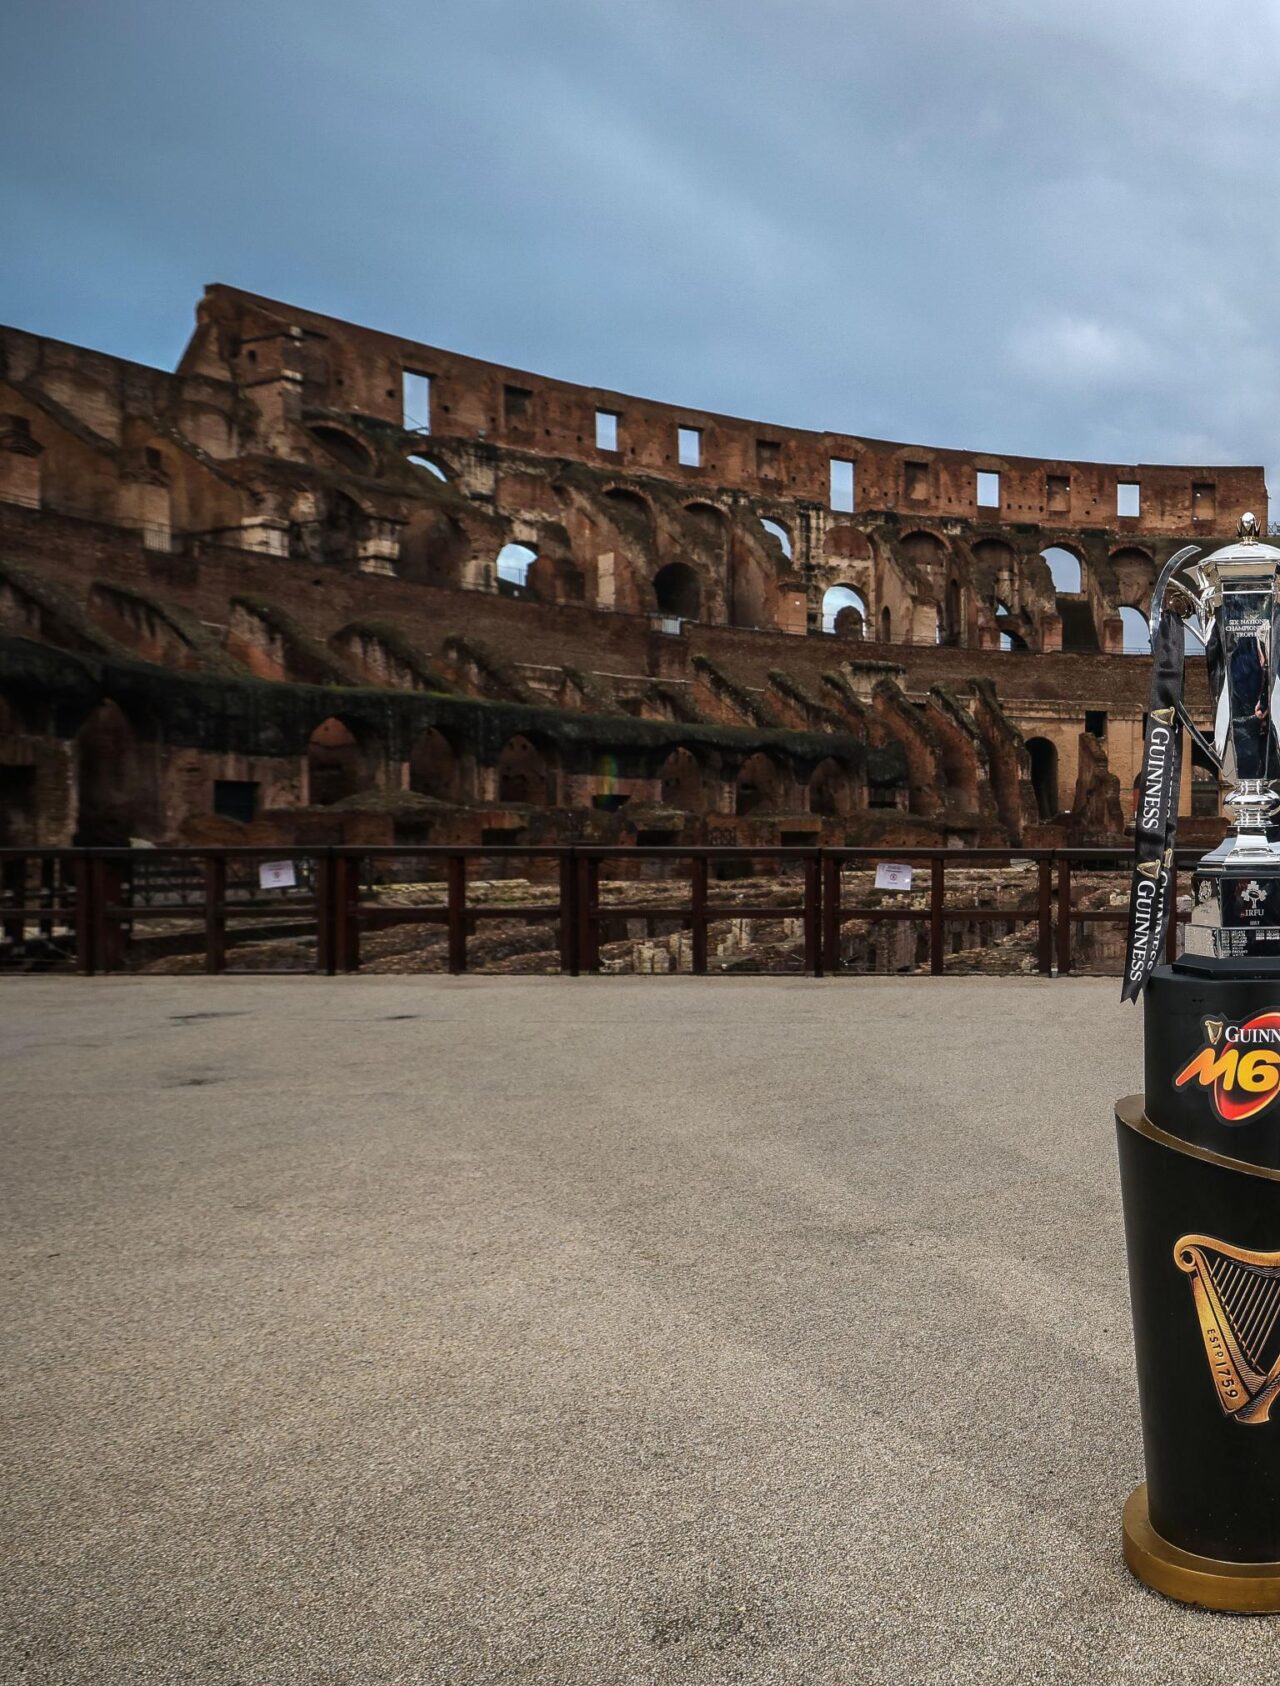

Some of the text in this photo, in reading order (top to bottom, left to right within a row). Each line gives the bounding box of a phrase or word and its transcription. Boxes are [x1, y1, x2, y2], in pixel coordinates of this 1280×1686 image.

[1142, 727, 1170, 829] GUINNESS
[1130, 880, 1156, 981] GUINNESS
[1215, 1362, 1239, 1398] 1759
